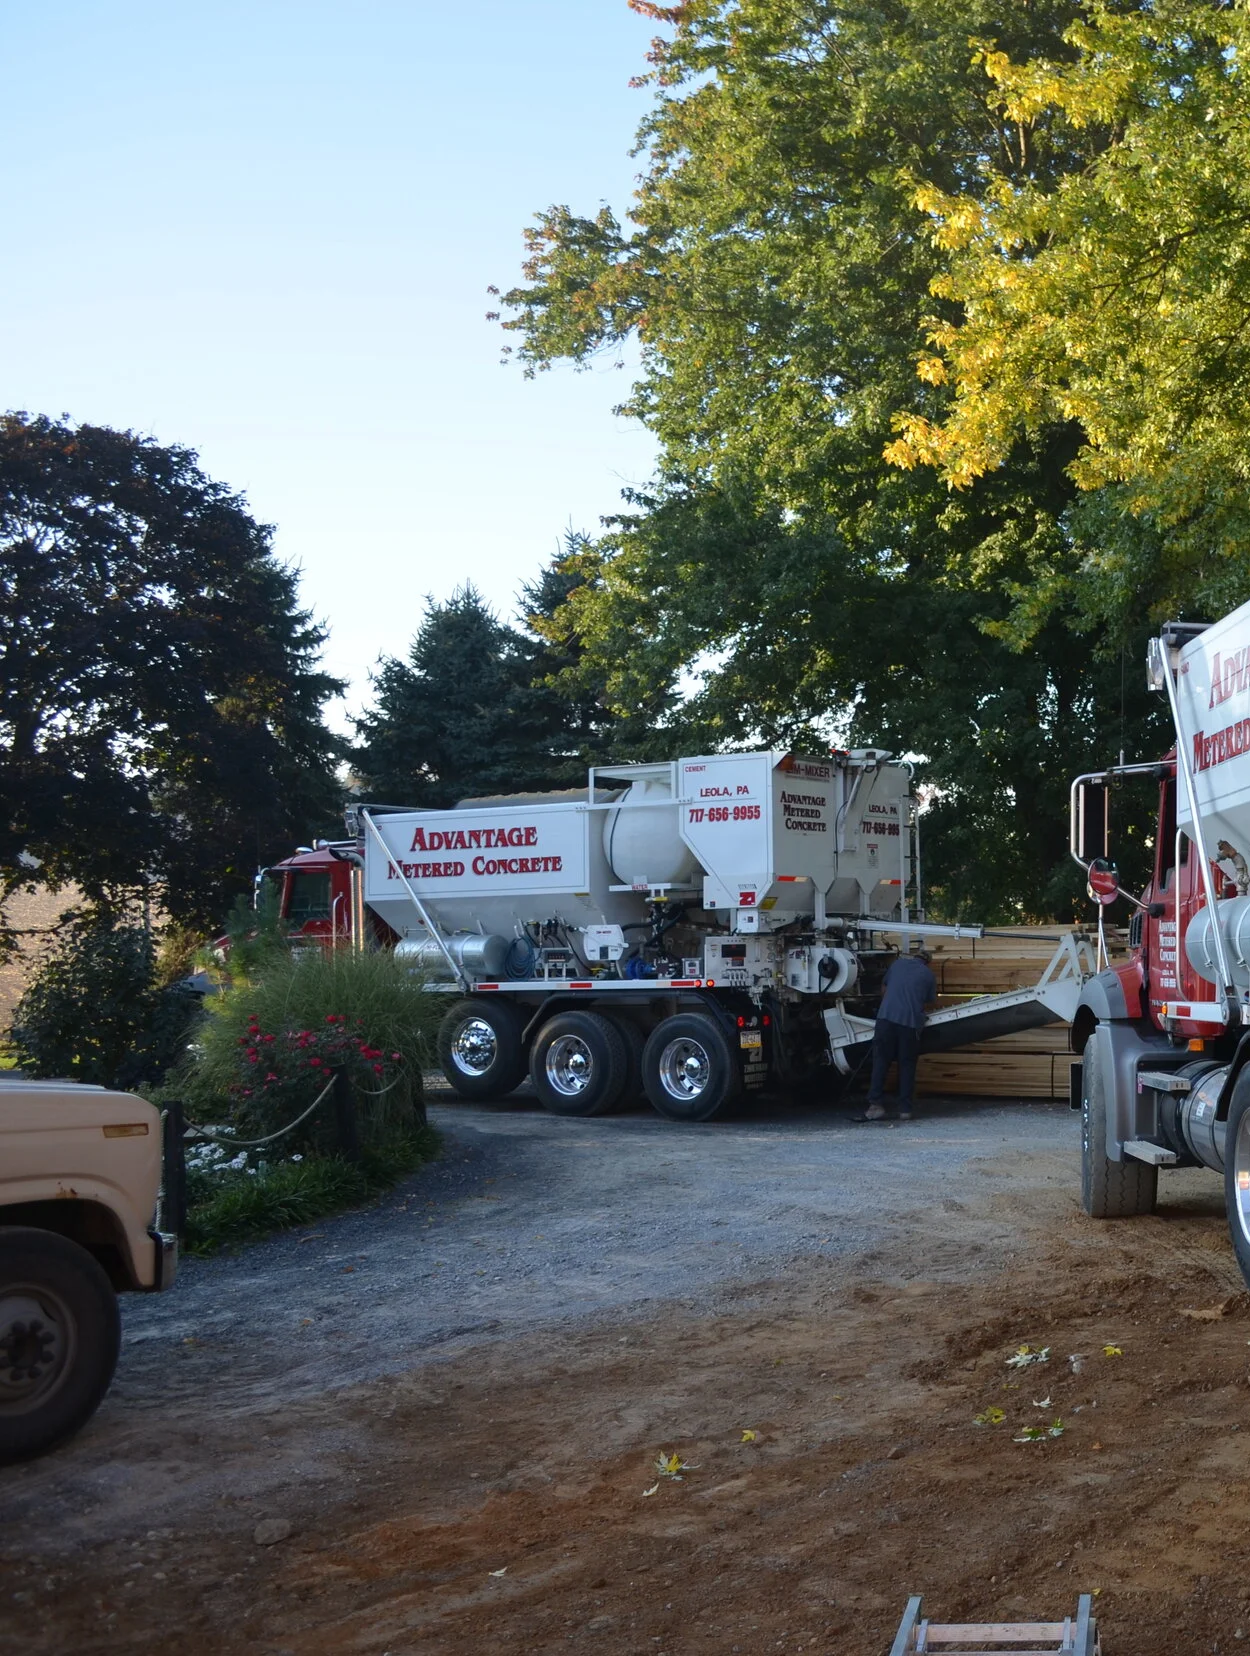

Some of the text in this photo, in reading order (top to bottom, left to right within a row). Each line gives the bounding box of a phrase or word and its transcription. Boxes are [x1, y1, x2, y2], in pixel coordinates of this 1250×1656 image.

[700, 785, 749, 797] LEOLA, PA
[780, 790, 826, 806] ADVANTAGE
[689, 805, 760, 823] 717-656-9955
[783, 804, 821, 818] METERED
[890, 806, 897, 815] PA
[785, 818, 827, 832] CONCRETE
[409, 826, 538, 851] ADVANTAGE
[472, 856, 563, 875] CONCRETE
